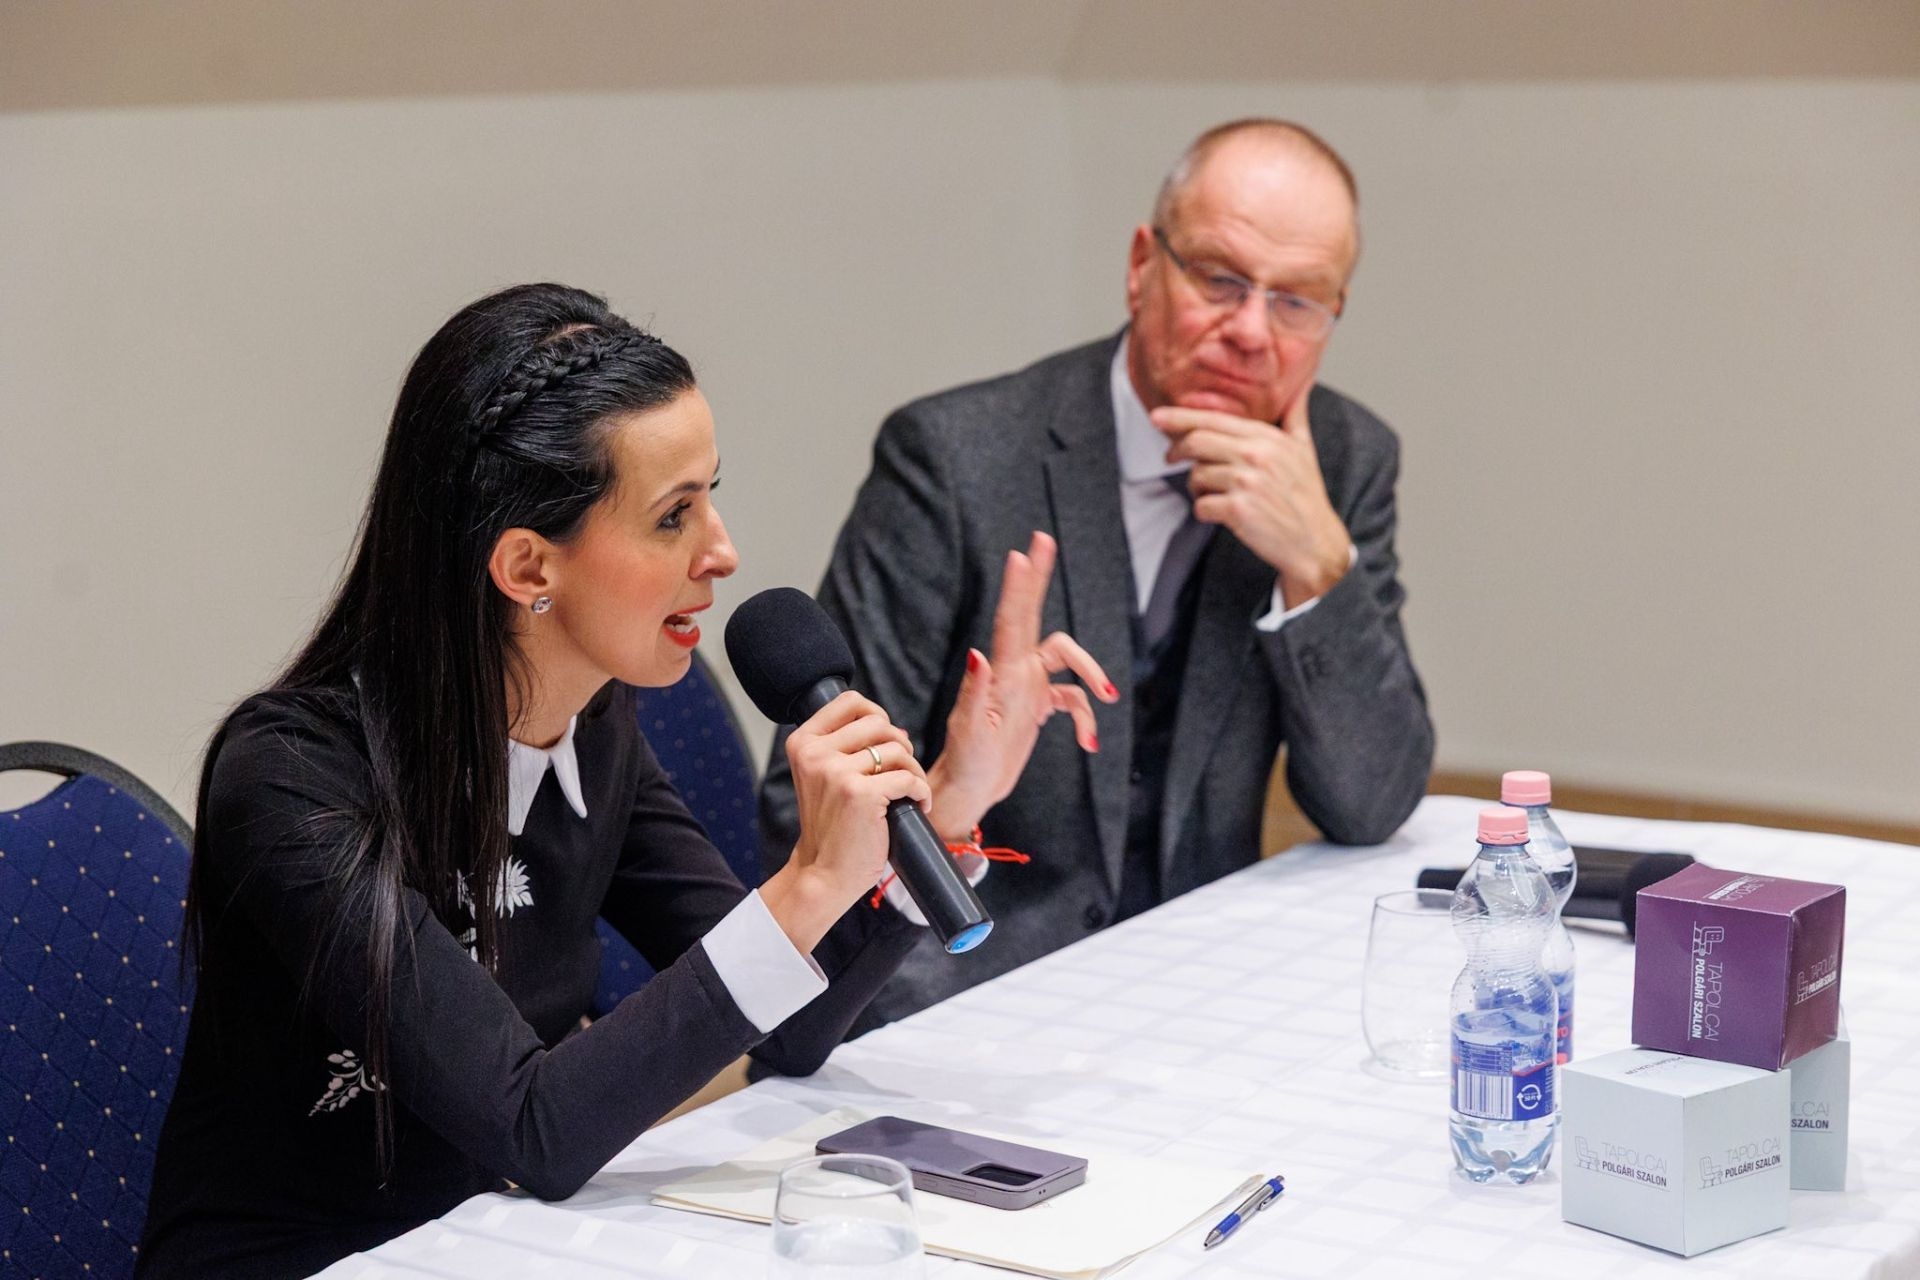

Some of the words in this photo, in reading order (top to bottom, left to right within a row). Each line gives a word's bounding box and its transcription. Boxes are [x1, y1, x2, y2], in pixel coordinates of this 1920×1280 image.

[1694, 958, 1706, 999] POLGÁRI
[1704, 962, 1723, 1041] TAPOLCAI
[1692, 1000, 1703, 1039] SZALON
[1791, 1101, 1829, 1117] LCAI
[1791, 1118, 1829, 1129] SZALON
[1601, 1142, 1667, 1174] TAPOLCAI
[1726, 1136, 1781, 1165] TAPOLCAI
[1602, 1160, 1635, 1178] POLGÁRI
[1636, 1170, 1667, 1187] SZALON
[1725, 1162, 1754, 1179] POLGÁRI
[1755, 1154, 1781, 1170] SZALON
